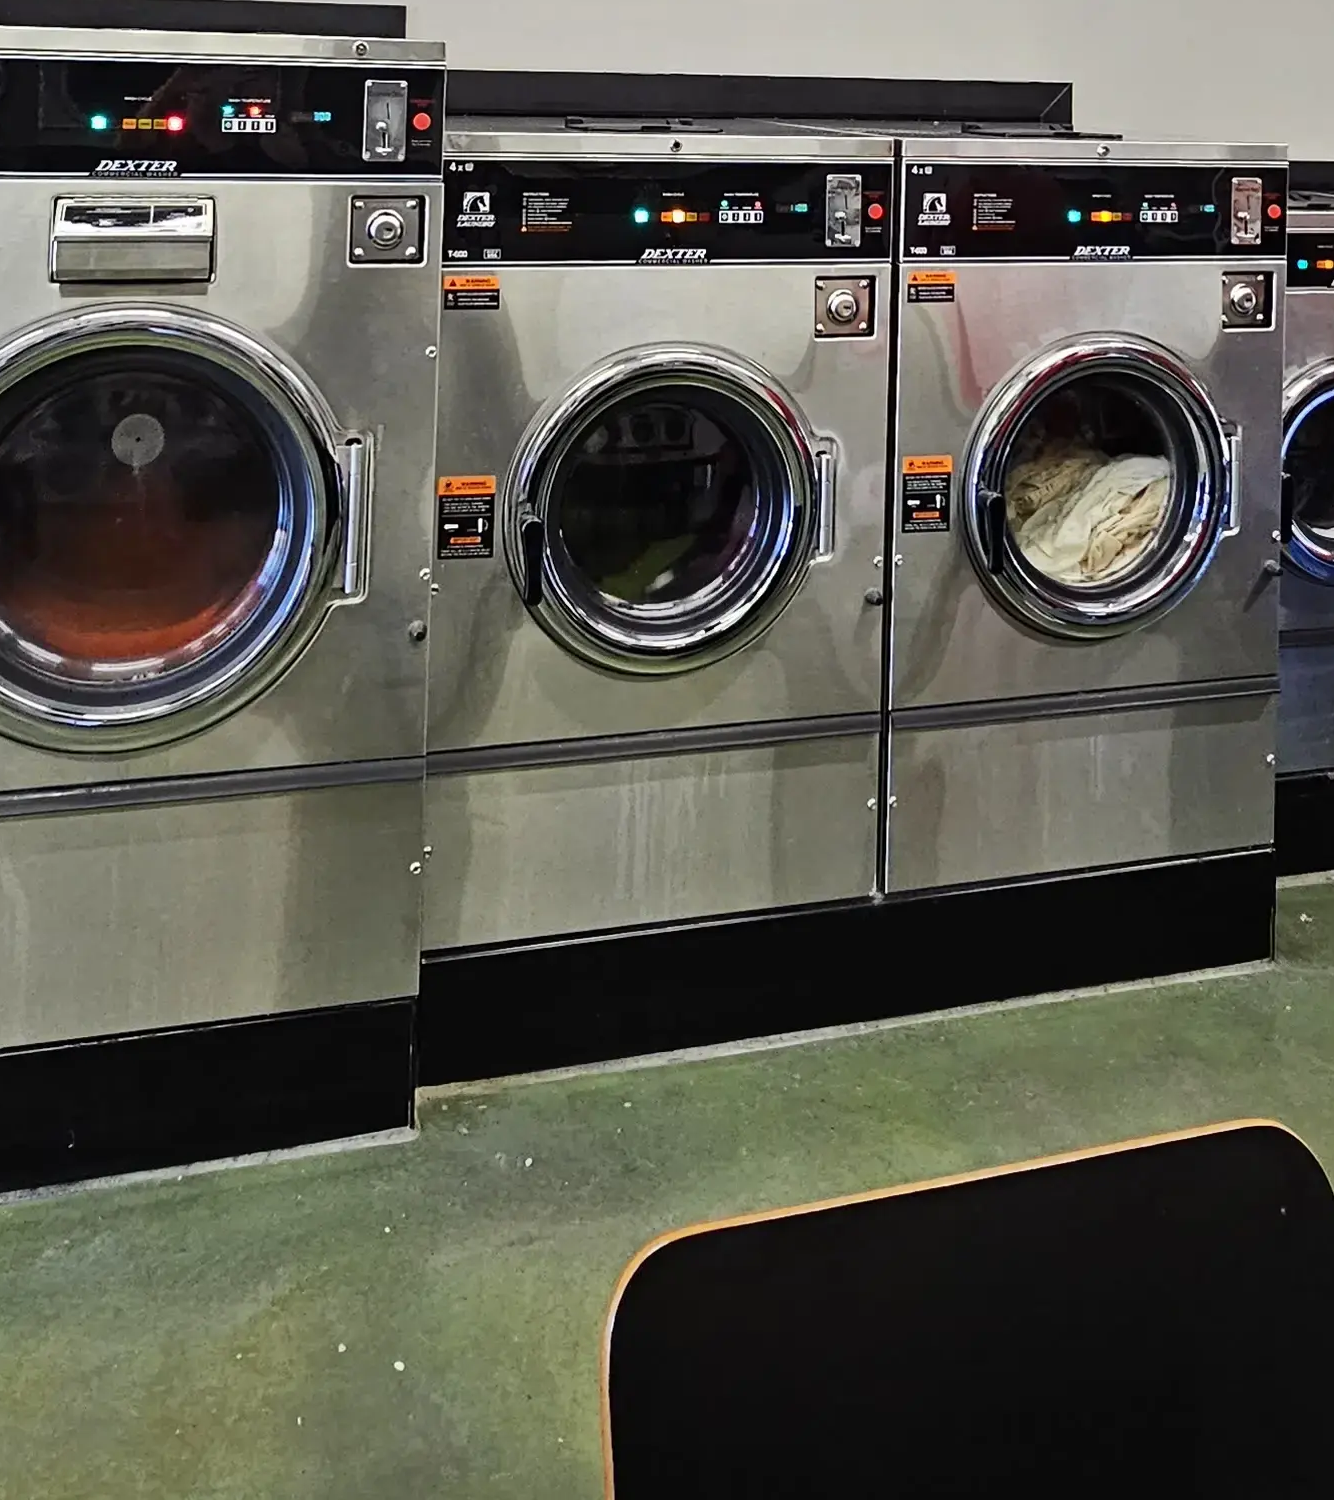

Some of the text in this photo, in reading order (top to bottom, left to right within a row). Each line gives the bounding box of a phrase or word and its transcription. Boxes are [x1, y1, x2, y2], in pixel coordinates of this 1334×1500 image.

[95, 159, 178, 172] DEXTER
[640, 248, 707, 259] DEXTER
[1073, 245, 1131, 256] DEXTER
